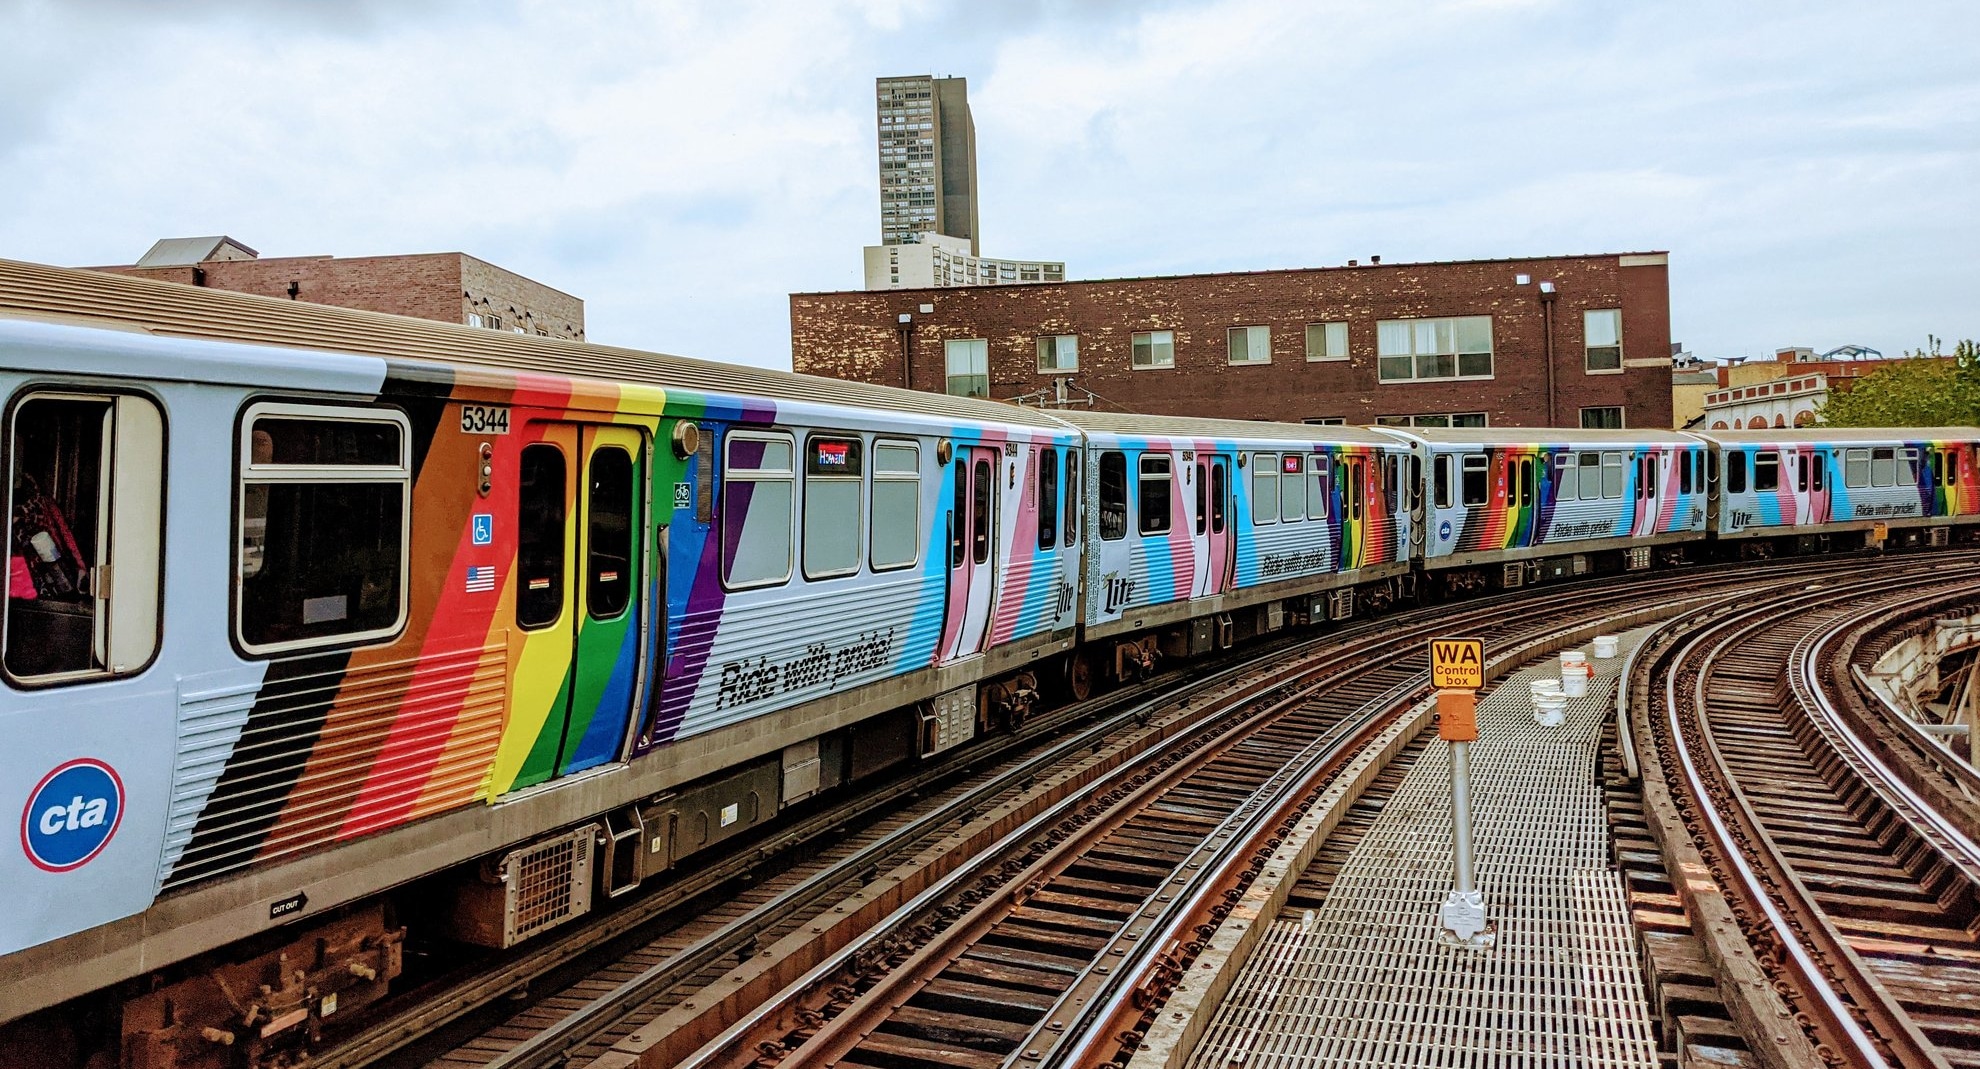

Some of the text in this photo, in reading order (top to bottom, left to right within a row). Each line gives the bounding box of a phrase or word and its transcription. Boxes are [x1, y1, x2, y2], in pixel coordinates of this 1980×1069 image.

[462, 406, 508, 432] 5344
[819, 449, 846, 465] Howard
[1856, 502, 1917, 517] Ride with pride!
[1554, 519, 1613, 538] Ride with pride!
[1731, 511, 1752, 529] Lite
[1262, 547, 1327, 576] Ride with pride!
[1054, 581, 1074, 623] Lite
[1104, 577, 1136, 615] Lite
[1435, 643, 1478, 664] WA
[715, 627, 894, 711] Ride with pride!
[1435, 665, 1479, 675] Control
[1446, 675, 1469, 686] box
[40, 795, 107, 835] cta
[272, 900, 298, 914] CUT OUT
